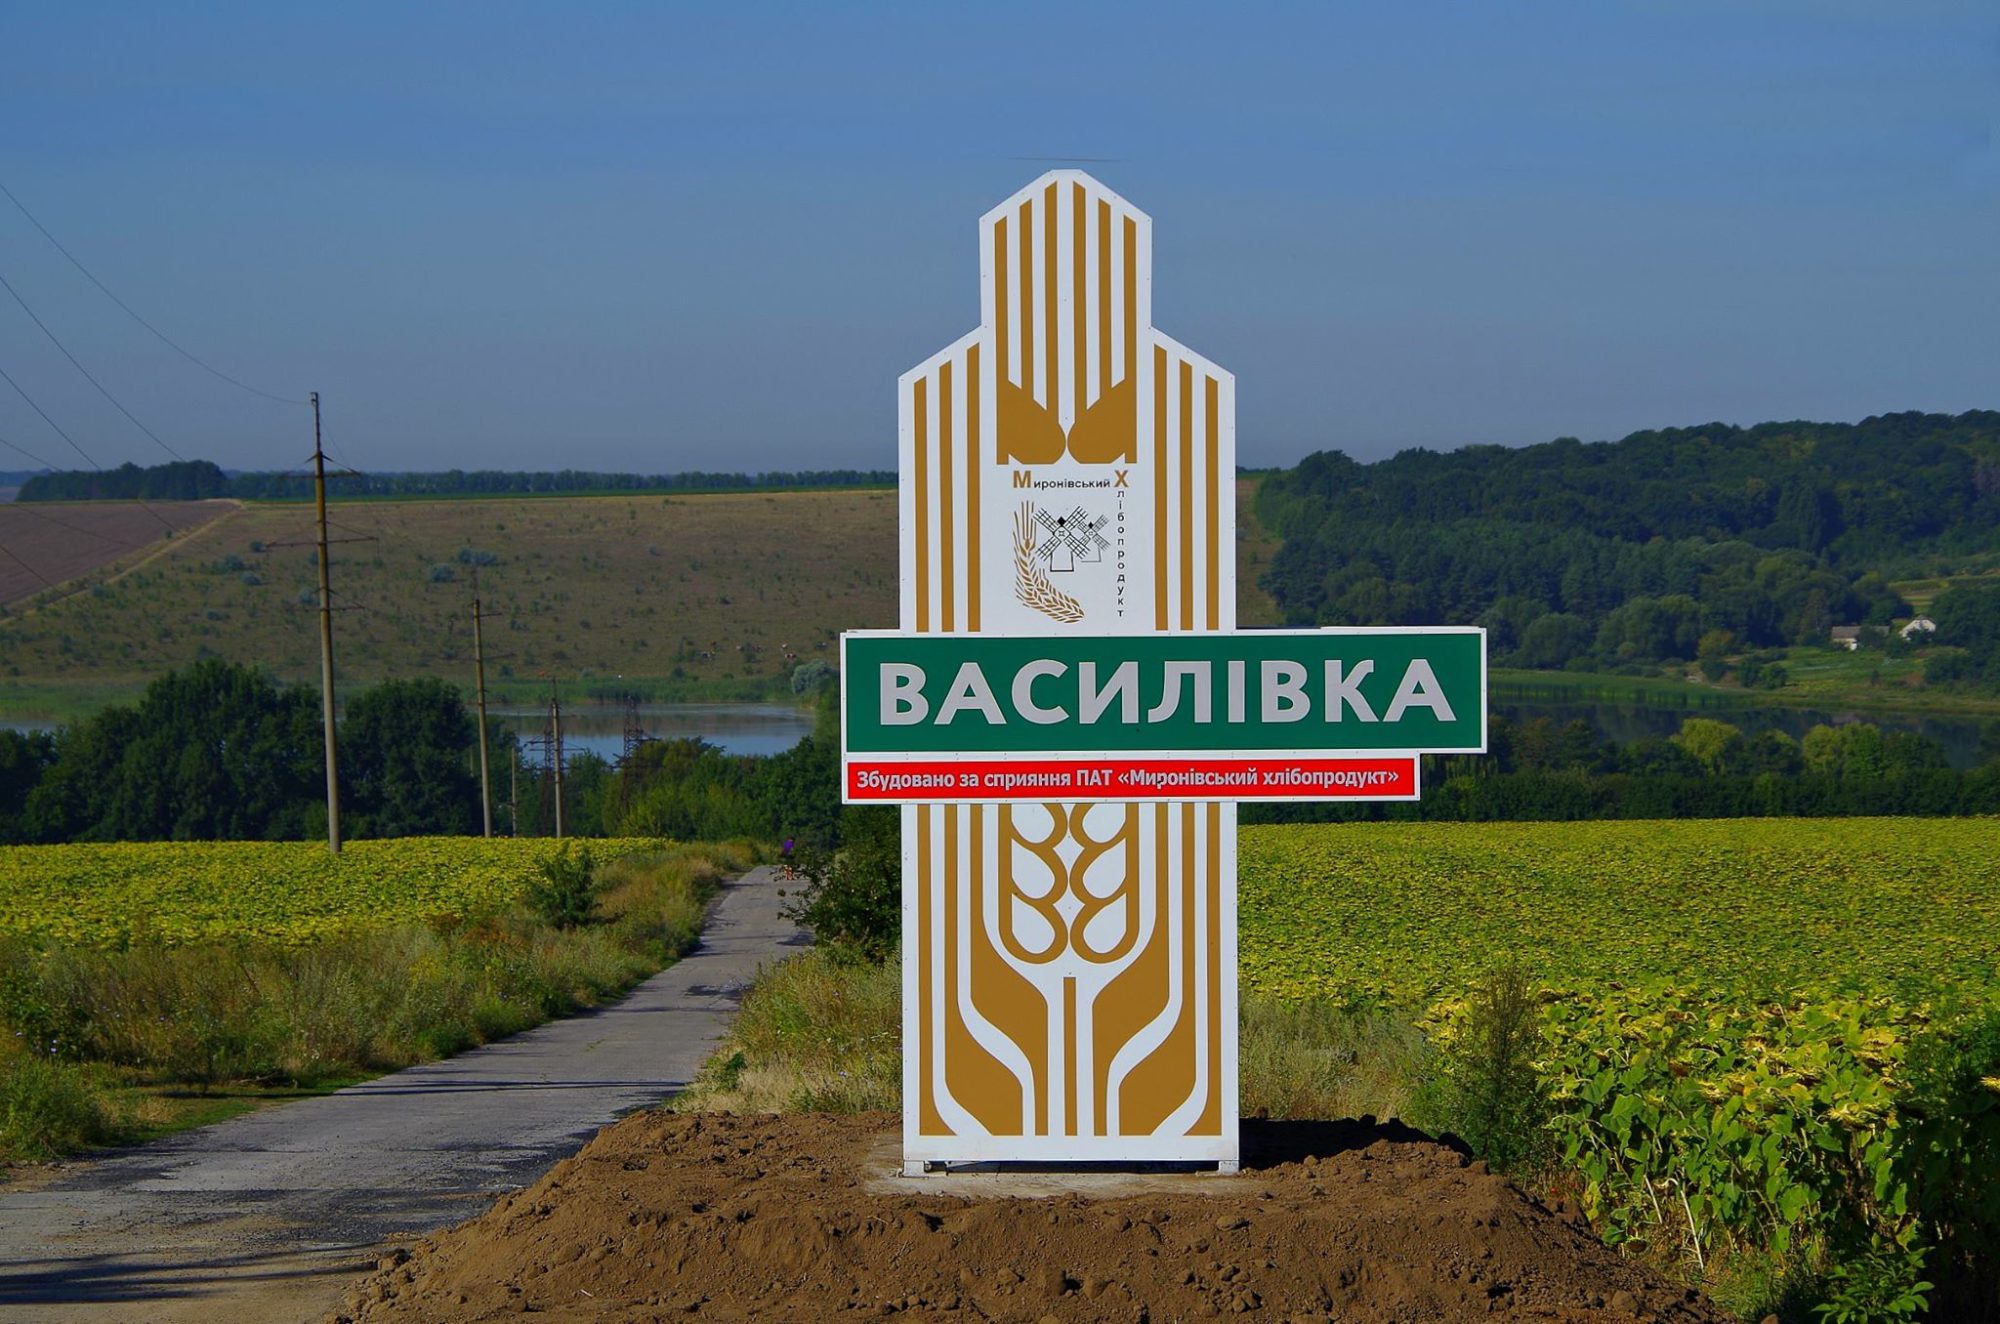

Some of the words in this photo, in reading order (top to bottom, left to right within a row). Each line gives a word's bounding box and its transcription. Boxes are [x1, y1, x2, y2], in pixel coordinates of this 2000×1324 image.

[1013, 470, 1110, 490] Миронівський
[880, 658, 1457, 726] ВАСИЛІВКА
[856, 770, 955, 791] Збудовано
[959, 773, 979, 787] за
[983, 772, 1071, 790] сприяння
[1076, 769, 1112, 787] ПАТ
[1117, 767, 1258, 790] «Миронівський
[1263, 767, 1399, 789] хлібопродукт»
